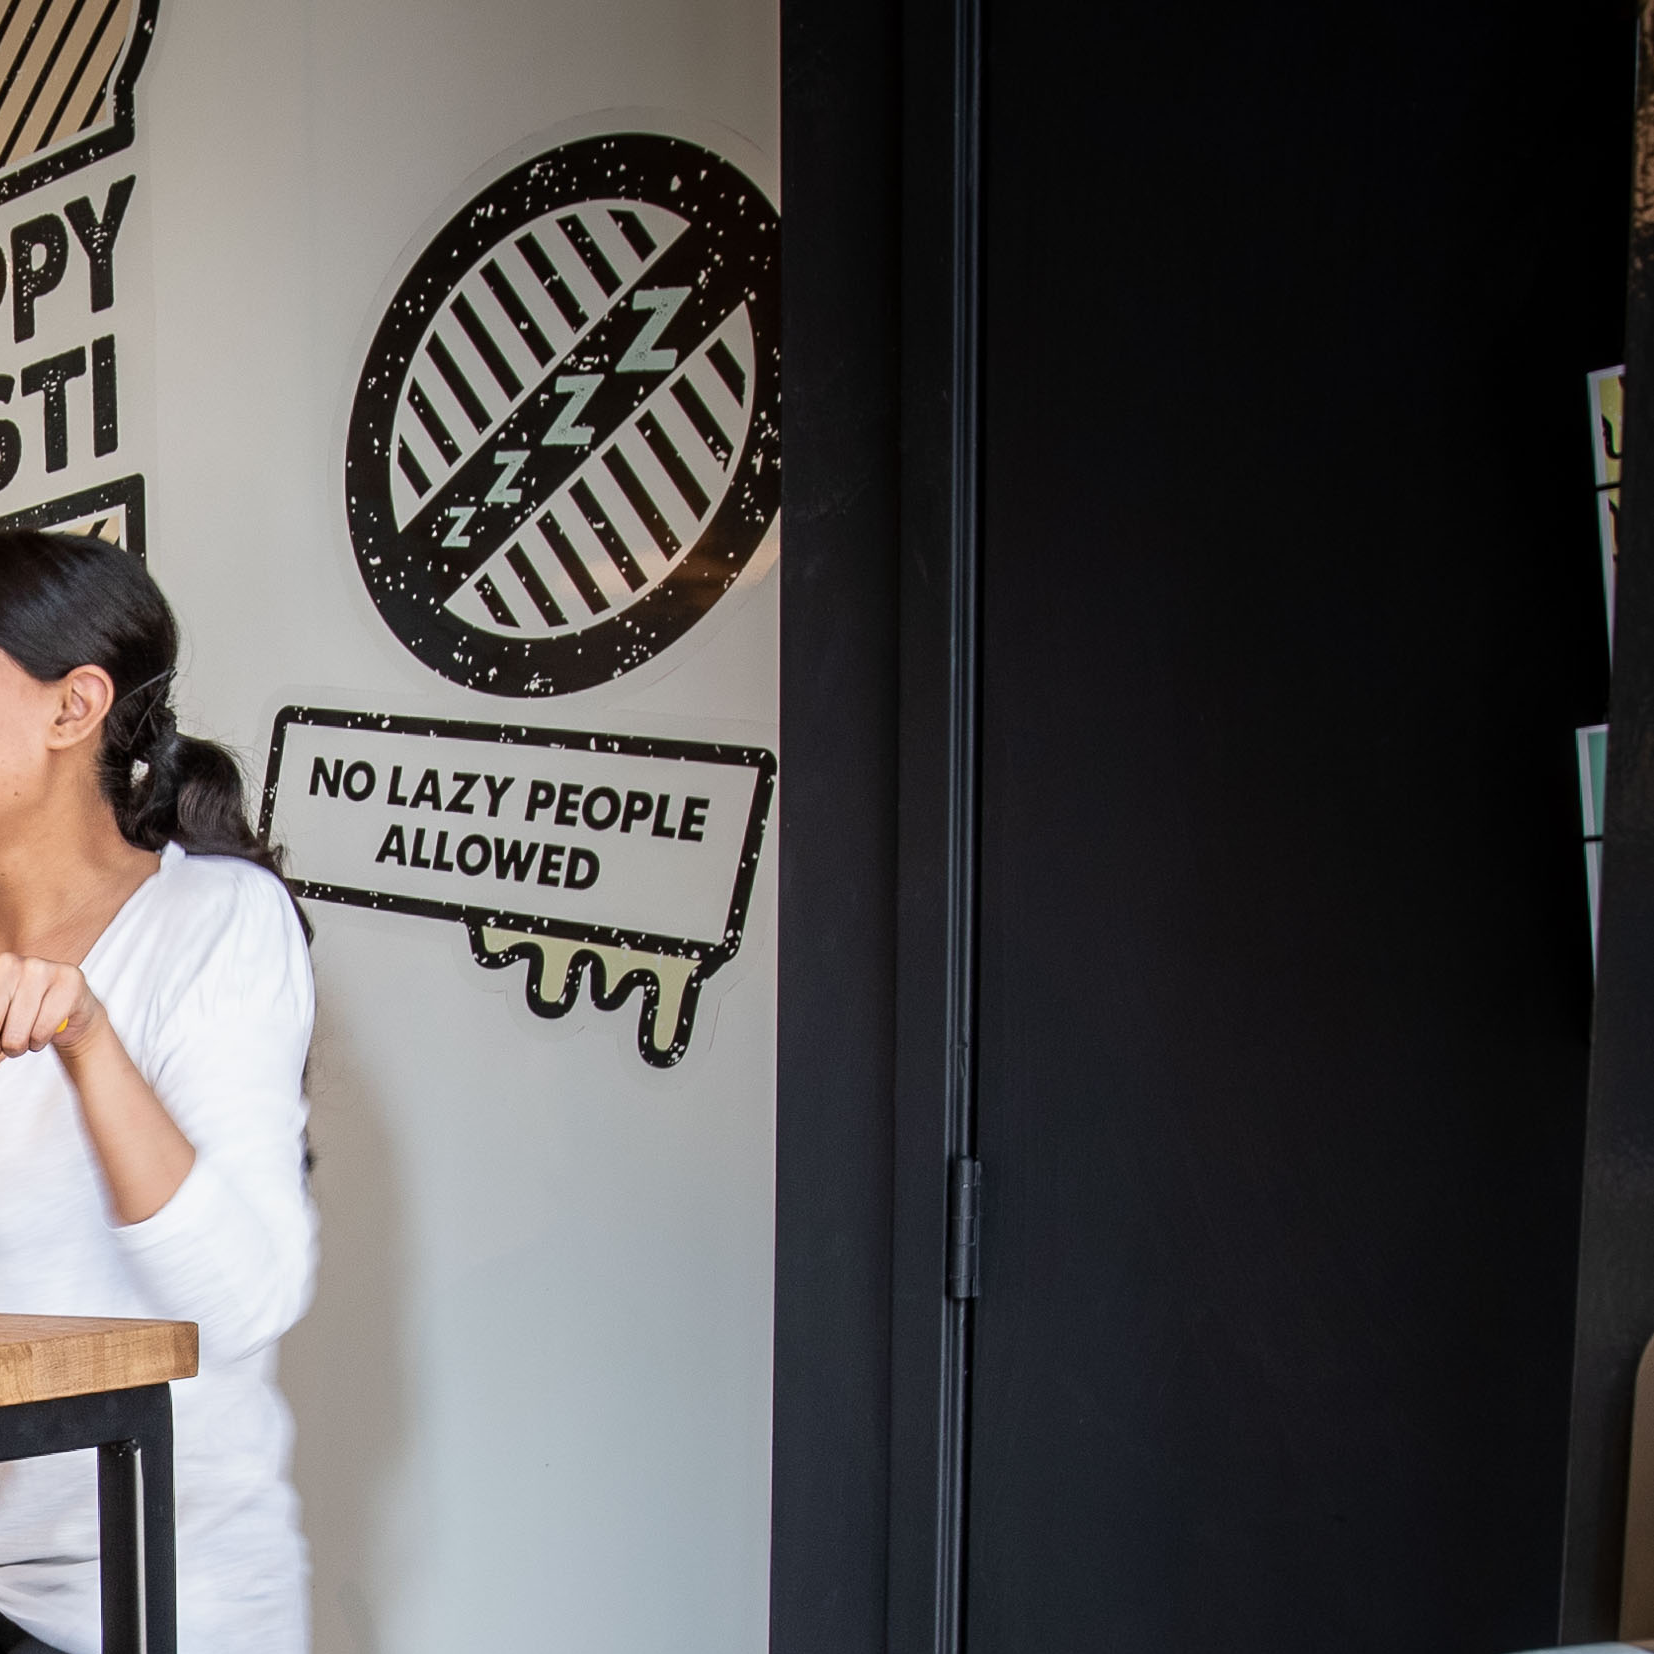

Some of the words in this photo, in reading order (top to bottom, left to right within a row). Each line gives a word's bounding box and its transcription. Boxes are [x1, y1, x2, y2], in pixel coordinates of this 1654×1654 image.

[308, 756, 376, 802] NO
[386, 765, 515, 817] LAZY
[524, 779, 711, 842] PEOPLE
[375, 824, 601, 890] ALLOWED
